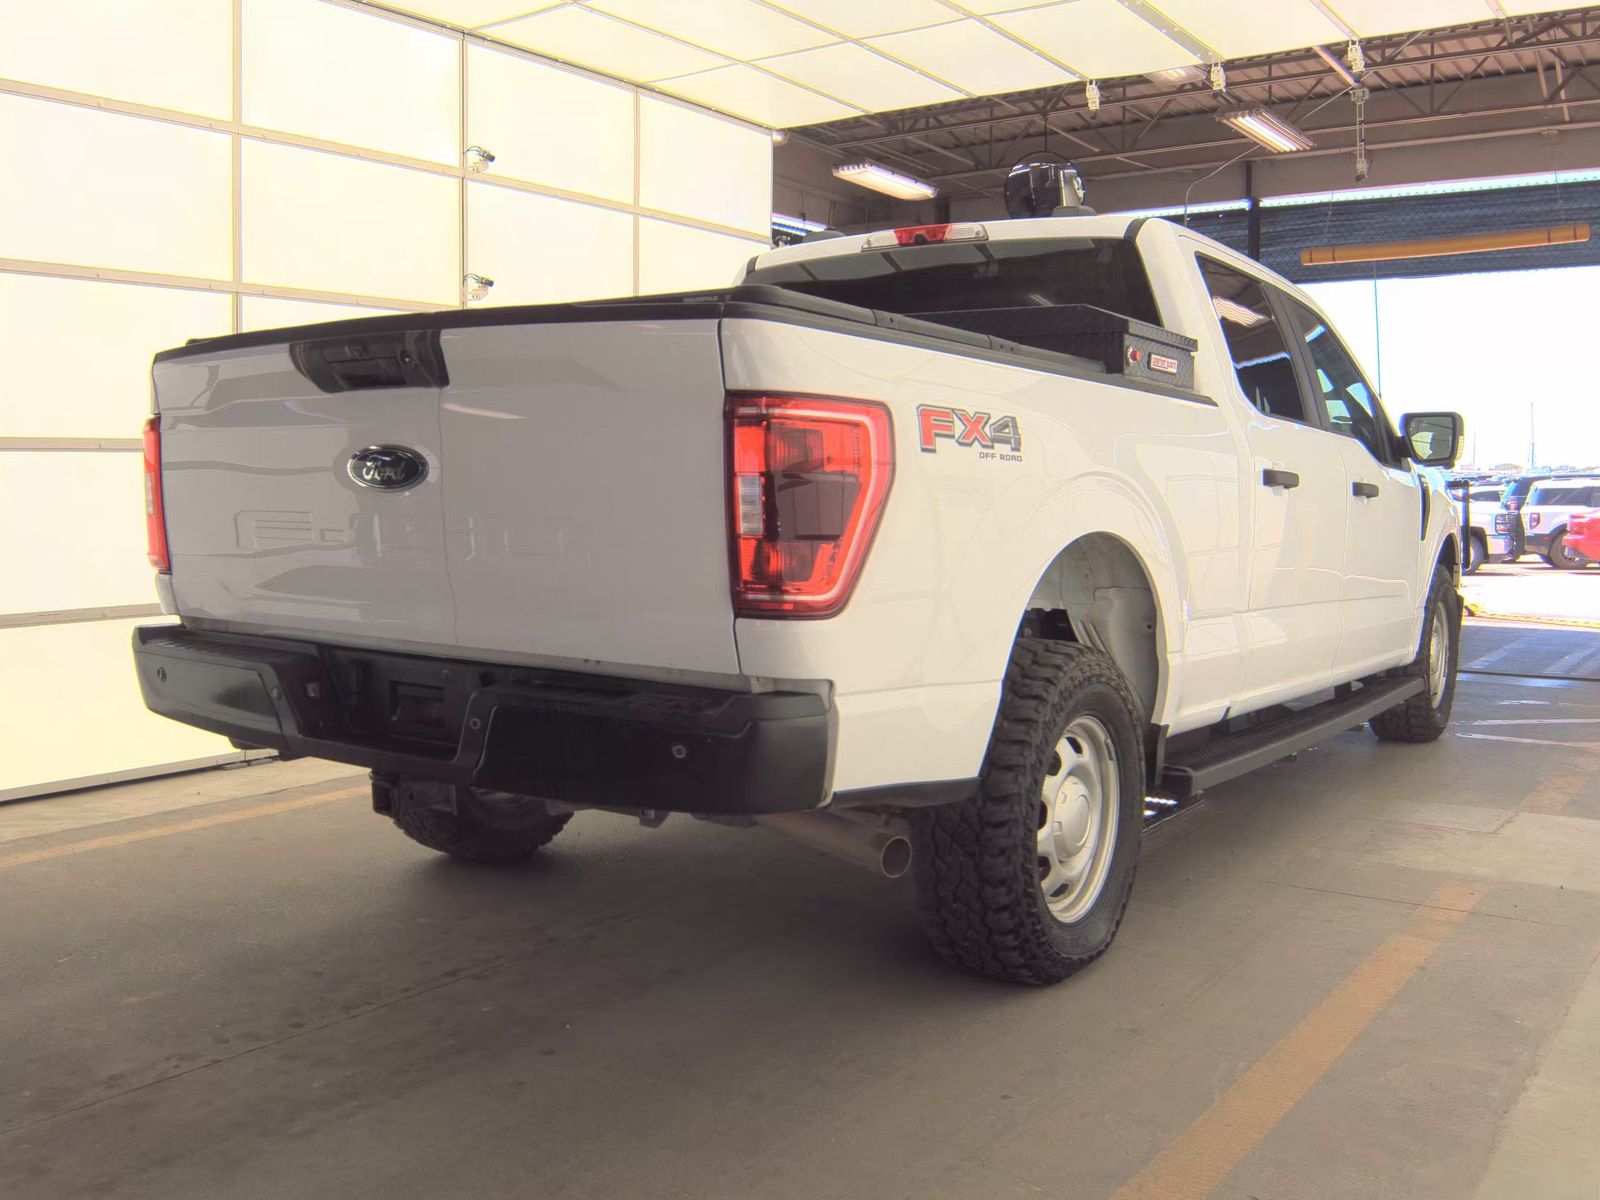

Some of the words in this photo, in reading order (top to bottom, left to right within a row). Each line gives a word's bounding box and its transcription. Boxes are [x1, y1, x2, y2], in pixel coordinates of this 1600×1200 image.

[916, 403, 1021, 454] FX4
[979, 451, 997, 460] OFF
[999, 453, 1023, 462] ROAD
